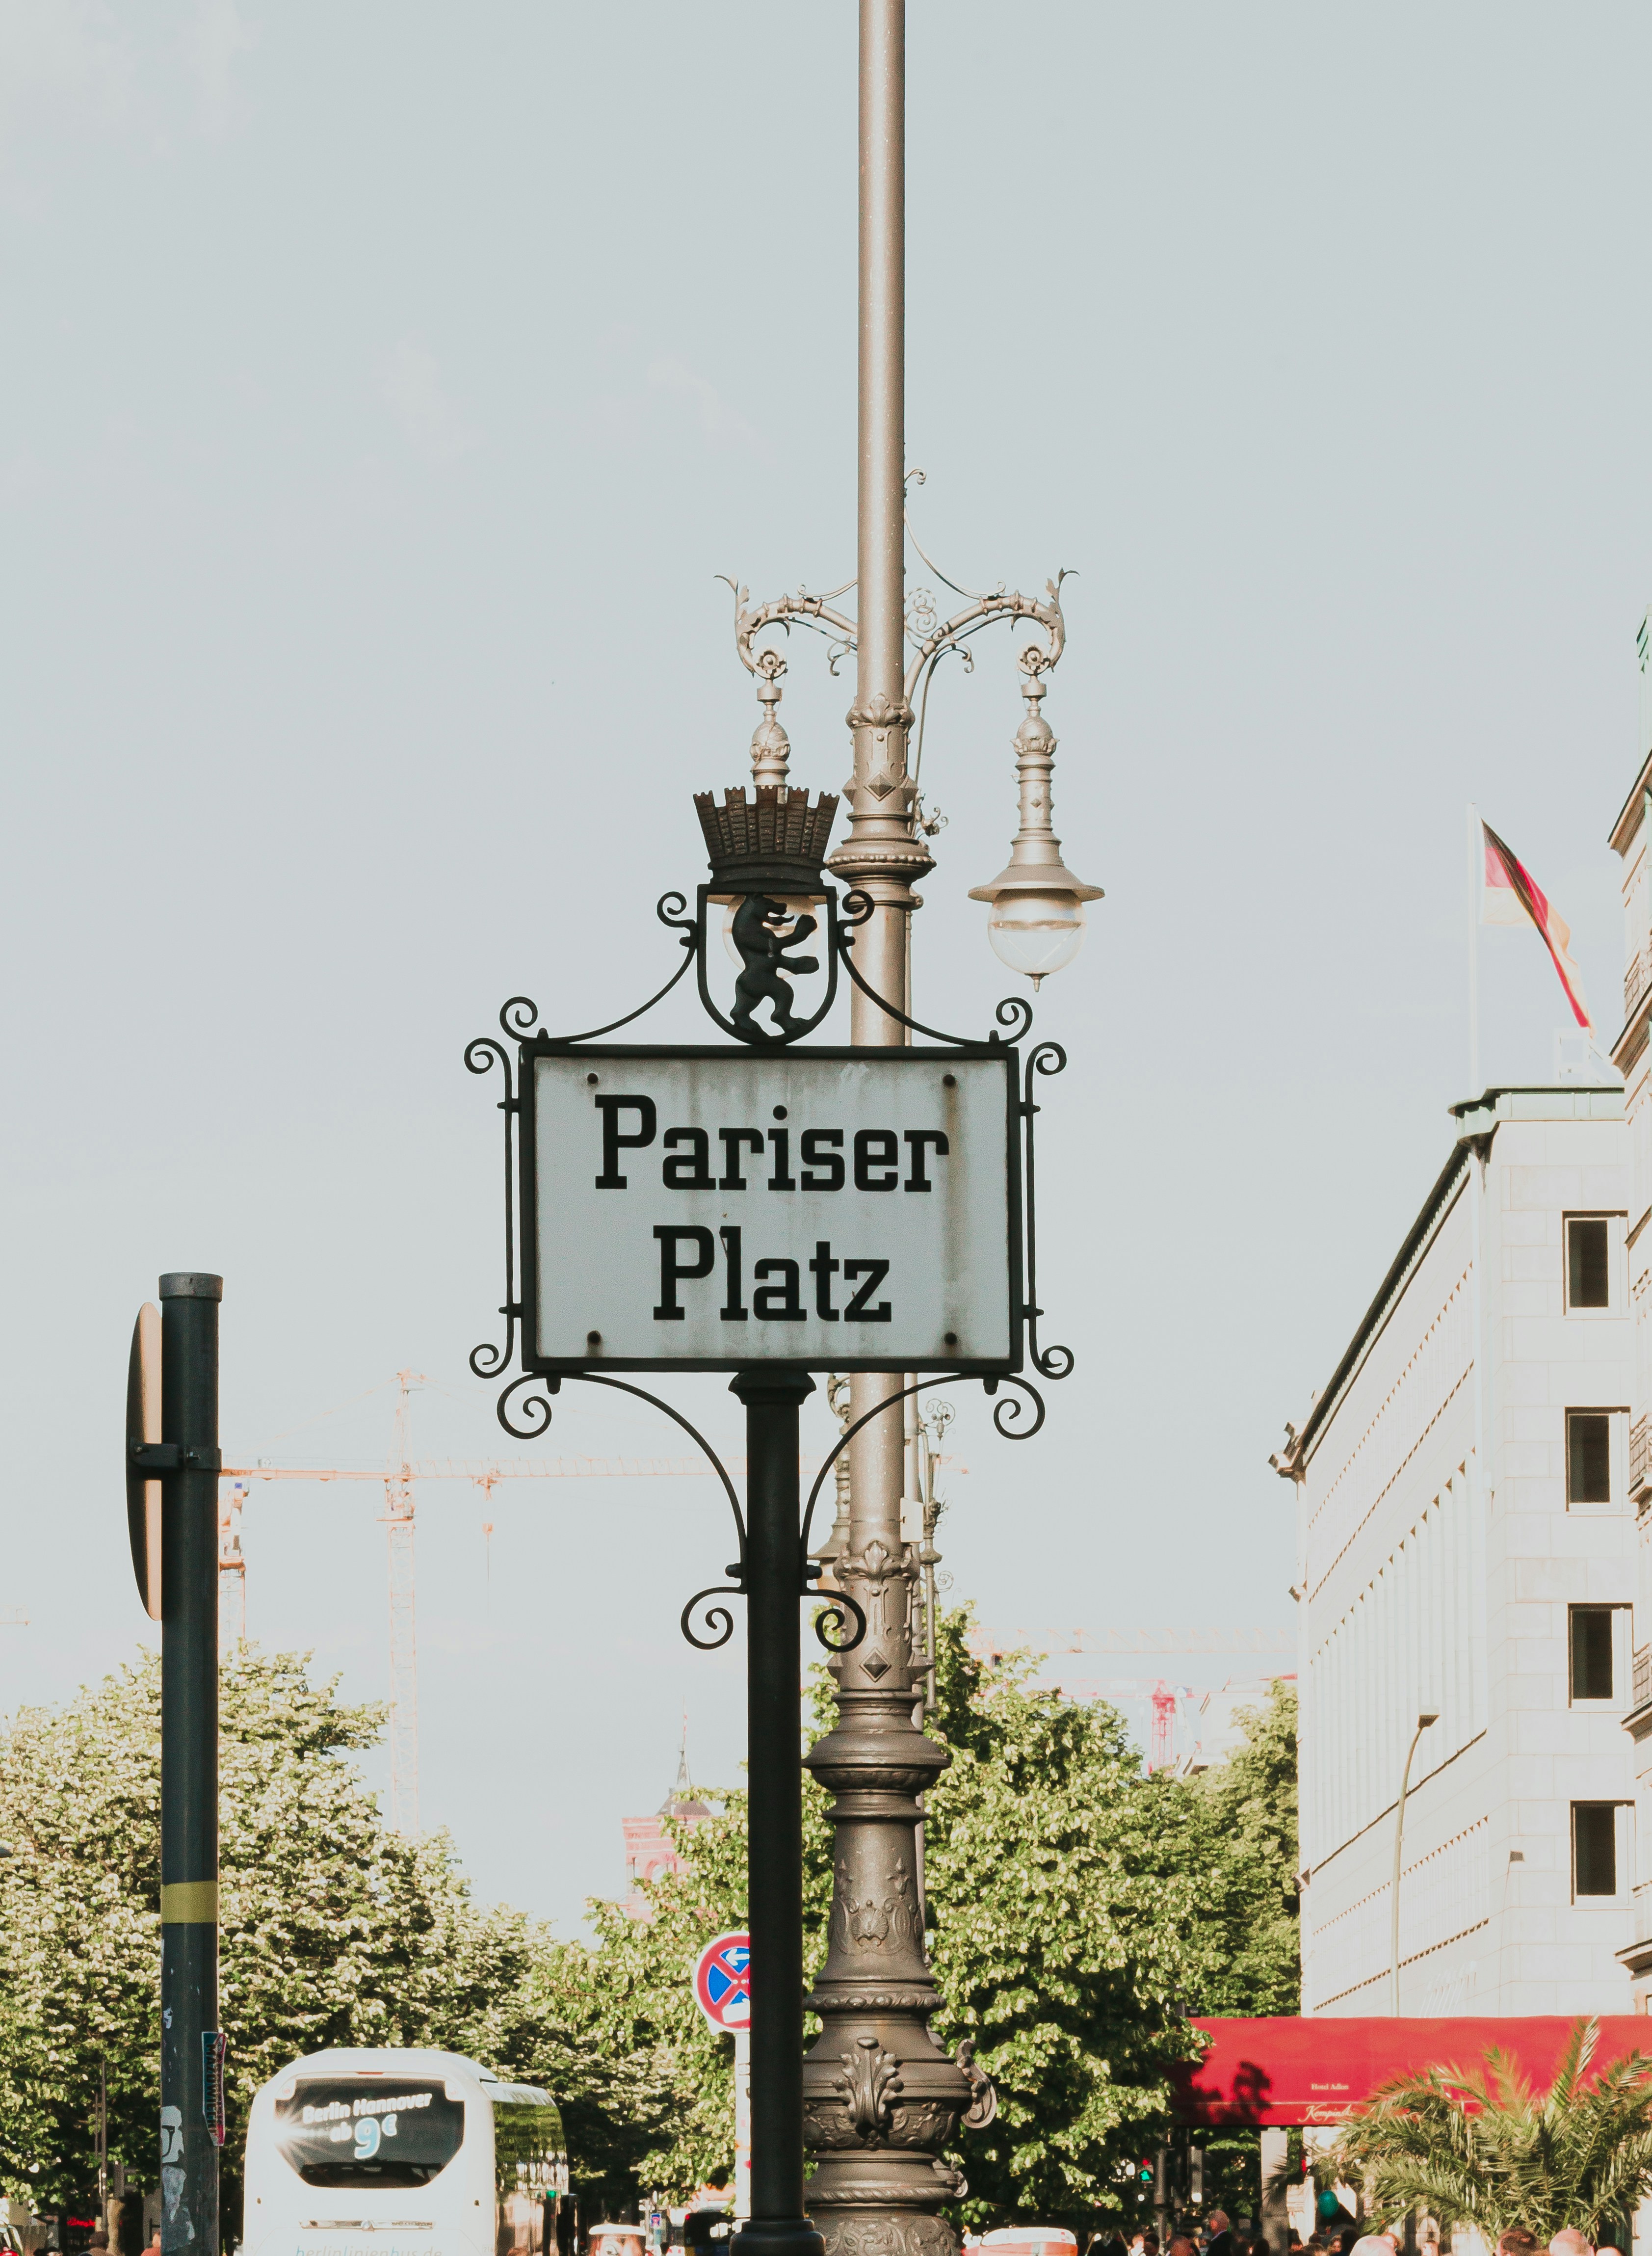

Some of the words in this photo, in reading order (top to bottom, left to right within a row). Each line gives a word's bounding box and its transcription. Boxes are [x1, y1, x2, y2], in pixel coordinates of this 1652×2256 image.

[595, 1094, 950, 1192] Pariser
[653, 1226, 892, 1322] Platz
[303, 2101, 351, 2124] Berlin
[353, 2093, 432, 2116] Hannover
[330, 2121, 352, 2142] ab
[296, 2245, 443, 2256] berlinlinienbusde
